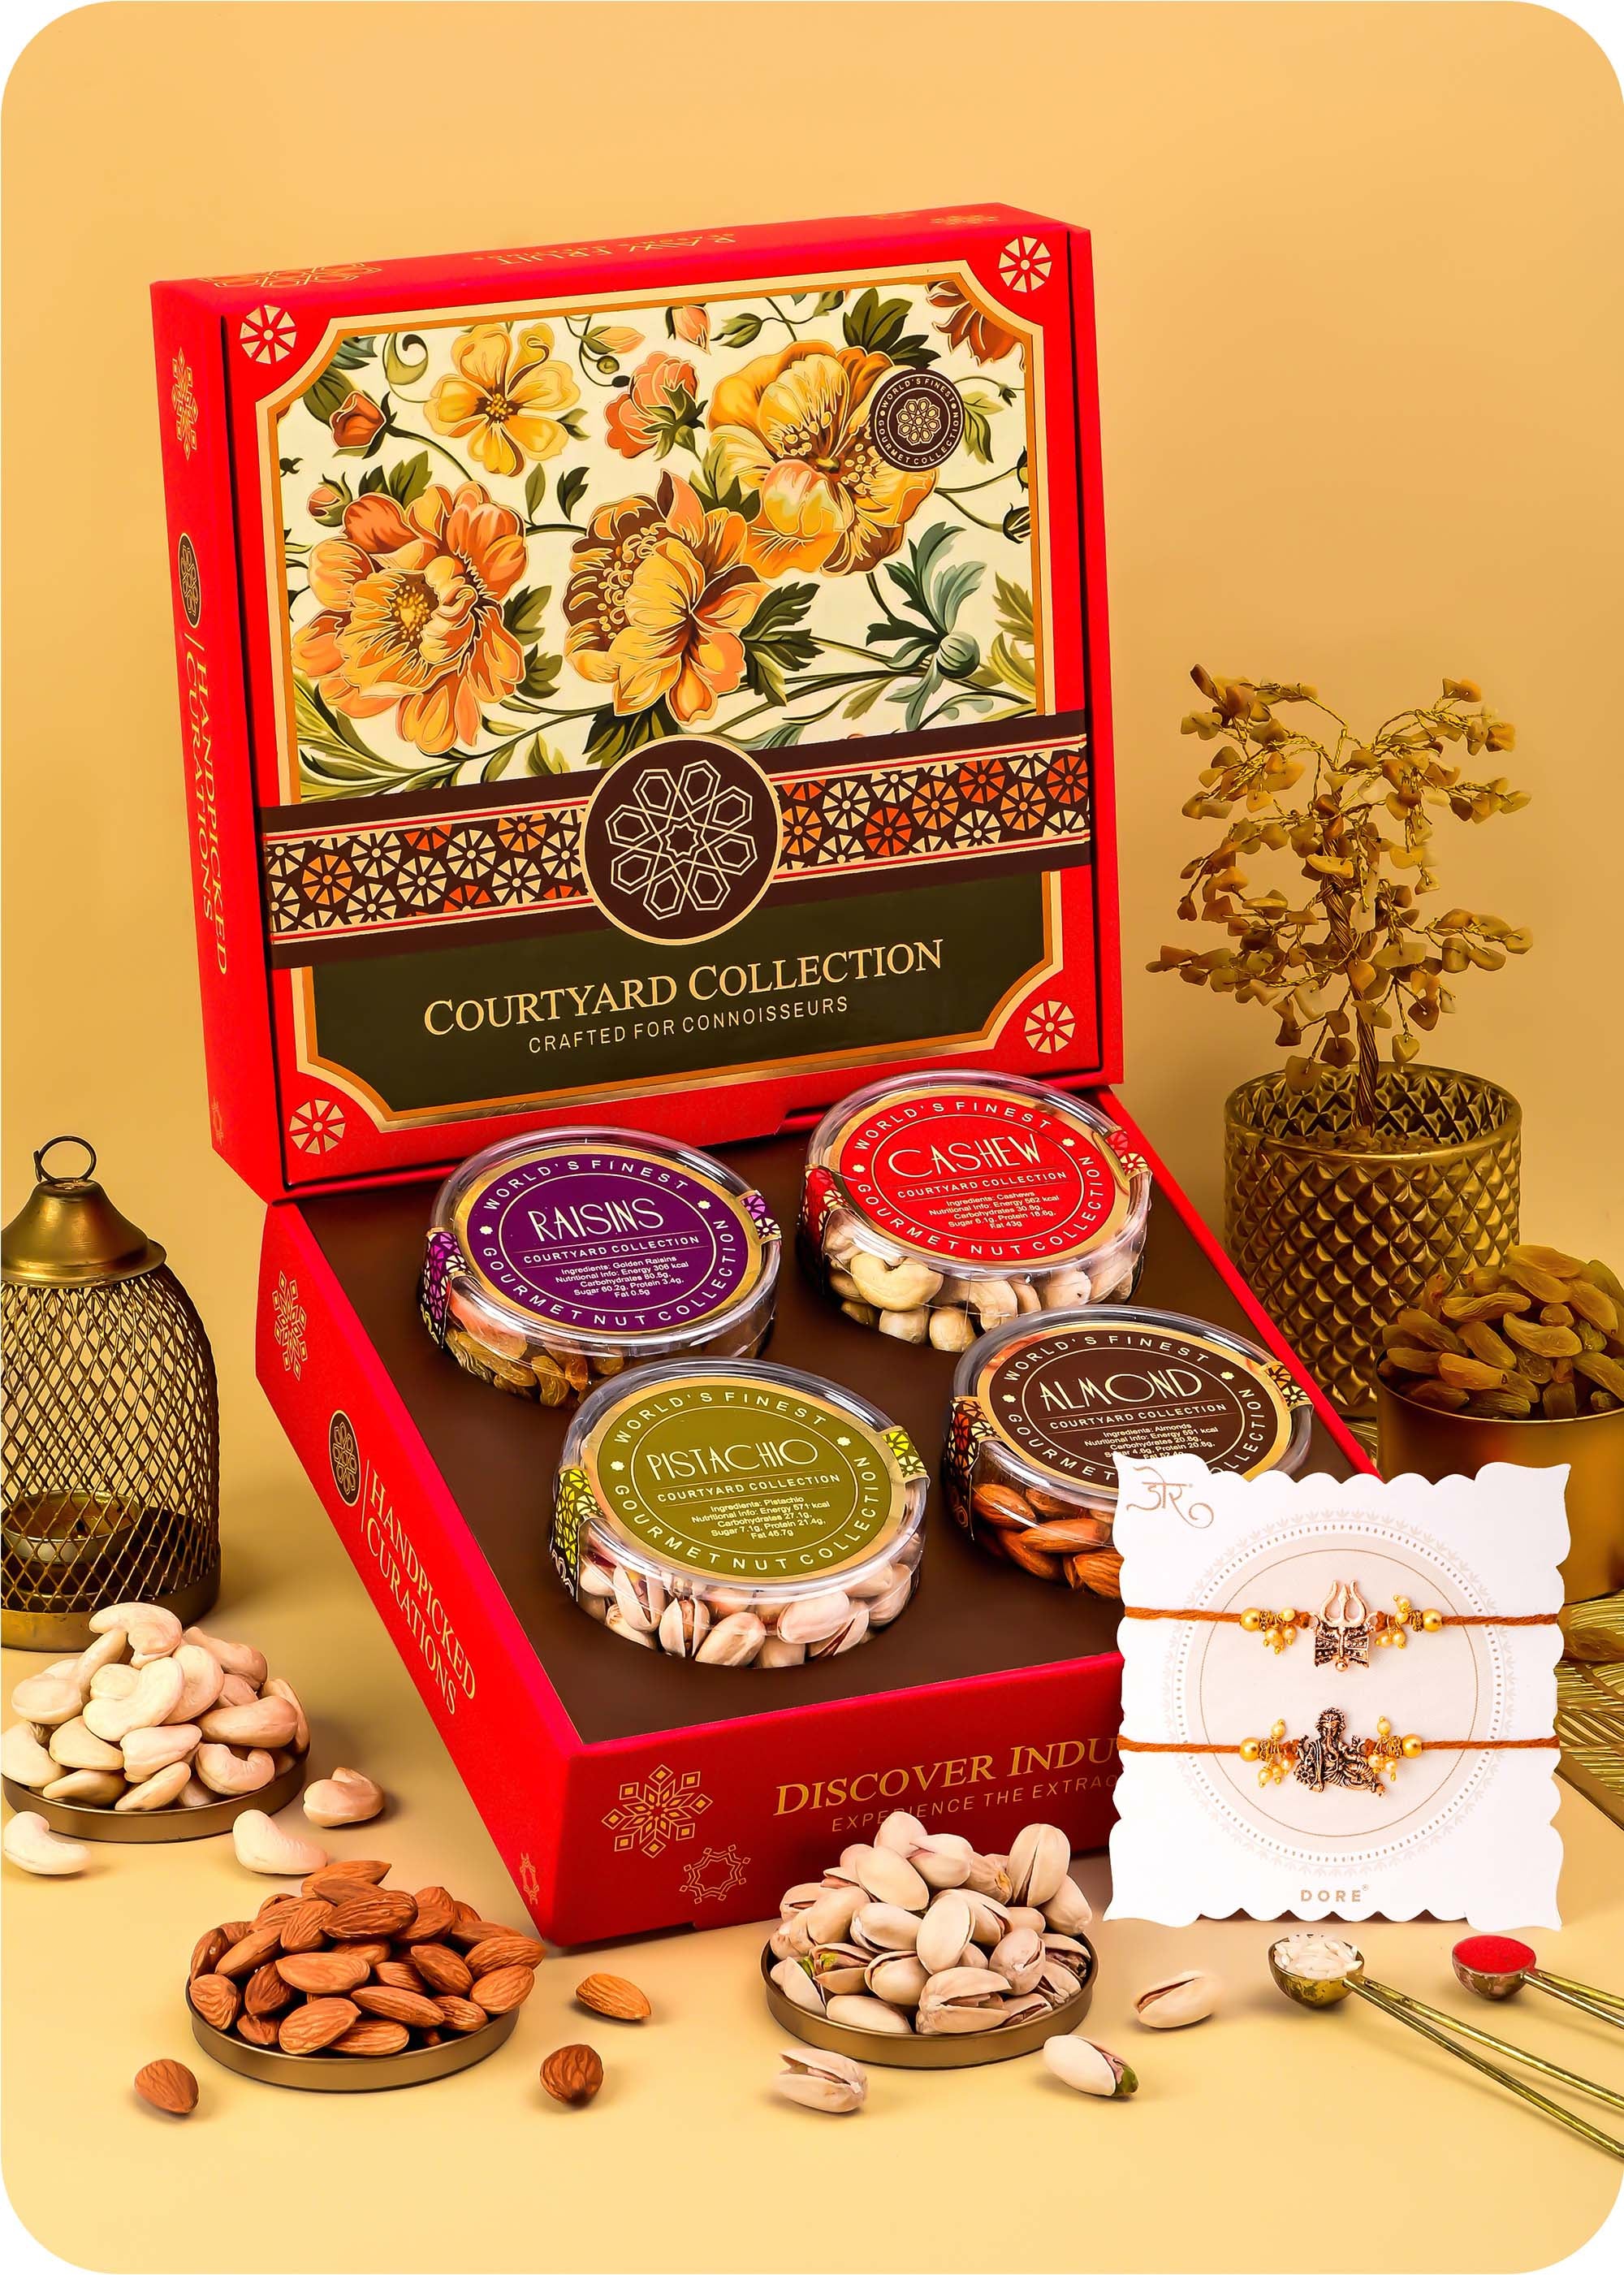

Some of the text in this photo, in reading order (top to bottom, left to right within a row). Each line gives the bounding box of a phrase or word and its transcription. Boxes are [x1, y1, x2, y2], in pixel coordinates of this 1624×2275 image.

[881, 378, 956, 409] WORLD'S FINEST
[878, 412, 959, 465] GOURMET COLLECTION
[186, 651, 213, 921] CURATIONS
[197, 657, 227, 975] HANDPICKED
[423, 938, 944, 1036] COURTYARD COLLECTION
[528, 995, 849, 1054] CRAFTED FOR CONNOISSEURS
[853, 1101, 1052, 1151] WORLD'S FINEST
[888, 1133, 1042, 1178] CASHEW
[483, 1160, 689, 1210] WORLD'S FINEST
[897, 1170, 1067, 1199] COURTYARD COLLECTION
[996, 1191, 1036, 1201] Cashews
[527, 1197, 664, 1242] RAISINS
[857, 1156, 1105, 1256] GOURMET NUT COLLECTION
[928, 1205, 973, 1216] Nutritional
[992, 1197, 1024, 1209] Energy
[1041, 1194, 1060, 1202] kcal
[948, 1219, 974, 1229] Sugar
[998, 1212, 1029, 1222] Protein
[953, 1207, 1015, 1220] Carbohydrates
[523, 1235, 700, 1264] COURTYARD COLLECTION
[612, 1258, 644, 1269] Golden
[645, 1255, 677, 1265] Raisins
[482, 1219, 737, 1327] GOURMET NUT COLLECTION
[555, 1272, 599, 1283] Nutritional
[620, 1265, 651, 1277] Energy
[671, 1261, 689, 1269] kcal
[580, 1275, 642, 1288] Carbohydrates
[573, 1287, 599, 1297] Sugar
[629, 1280, 661, 1290] Protein
[614, 1291, 630, 1299] Fat
[1004, 1334, 1210, 1382] WORLD'S FINEST
[1039, 1368, 1203, 1412] ALMOND
[614, 1391, 827, 1444] WORLD'S FINEST
[1049, 1403, 1228, 1429] COURTYARD COLLECTION
[1155, 1423, 1193, 1433] Almonds
[1209, 1389, 1266, 1473] LLECTION
[1008, 1413, 1116, 1481] GOURMET
[1084, 1437, 1129, 1447] Nutritional
[1150, 1429, 1181, 1440] Energy
[1200, 1426, 1220, 1434] kcal
[1104, 1450, 1131, 1459] Sar
[1155, 1444, 1188, 1454] Protein
[1110, 1439, 1173, 1451] Carbohydrates
[646, 1438, 818, 1481] PISTACHIO
[657, 1474, 840, 1502] COURTYARD COLLECTION
[763, 1495, 805, 1506] Pistachio
[613, 1456, 879, 1571] GOURMET NUT COLLECTION
[691, 1512, 737, 1524] Nutritional
[758, 1504, 792, 1516] Energy
[810, 1501, 831, 1509] kcal
[717, 1516, 783, 1528] Carbohydrates
[710, 1528, 738, 1538] Sugar
[764, 1521, 797, 1530] Protein
[750, 1532, 767, 1540] Fat
[369, 1468, 476, 1700] HANDPICKED
[367, 1516, 456, 1715] CURATIONS
[773, 1754, 998, 1816] DISCOVER
[831, 1796, 975, 1832] EXPEIENCE
[983, 1788, 1023, 1807] THE
